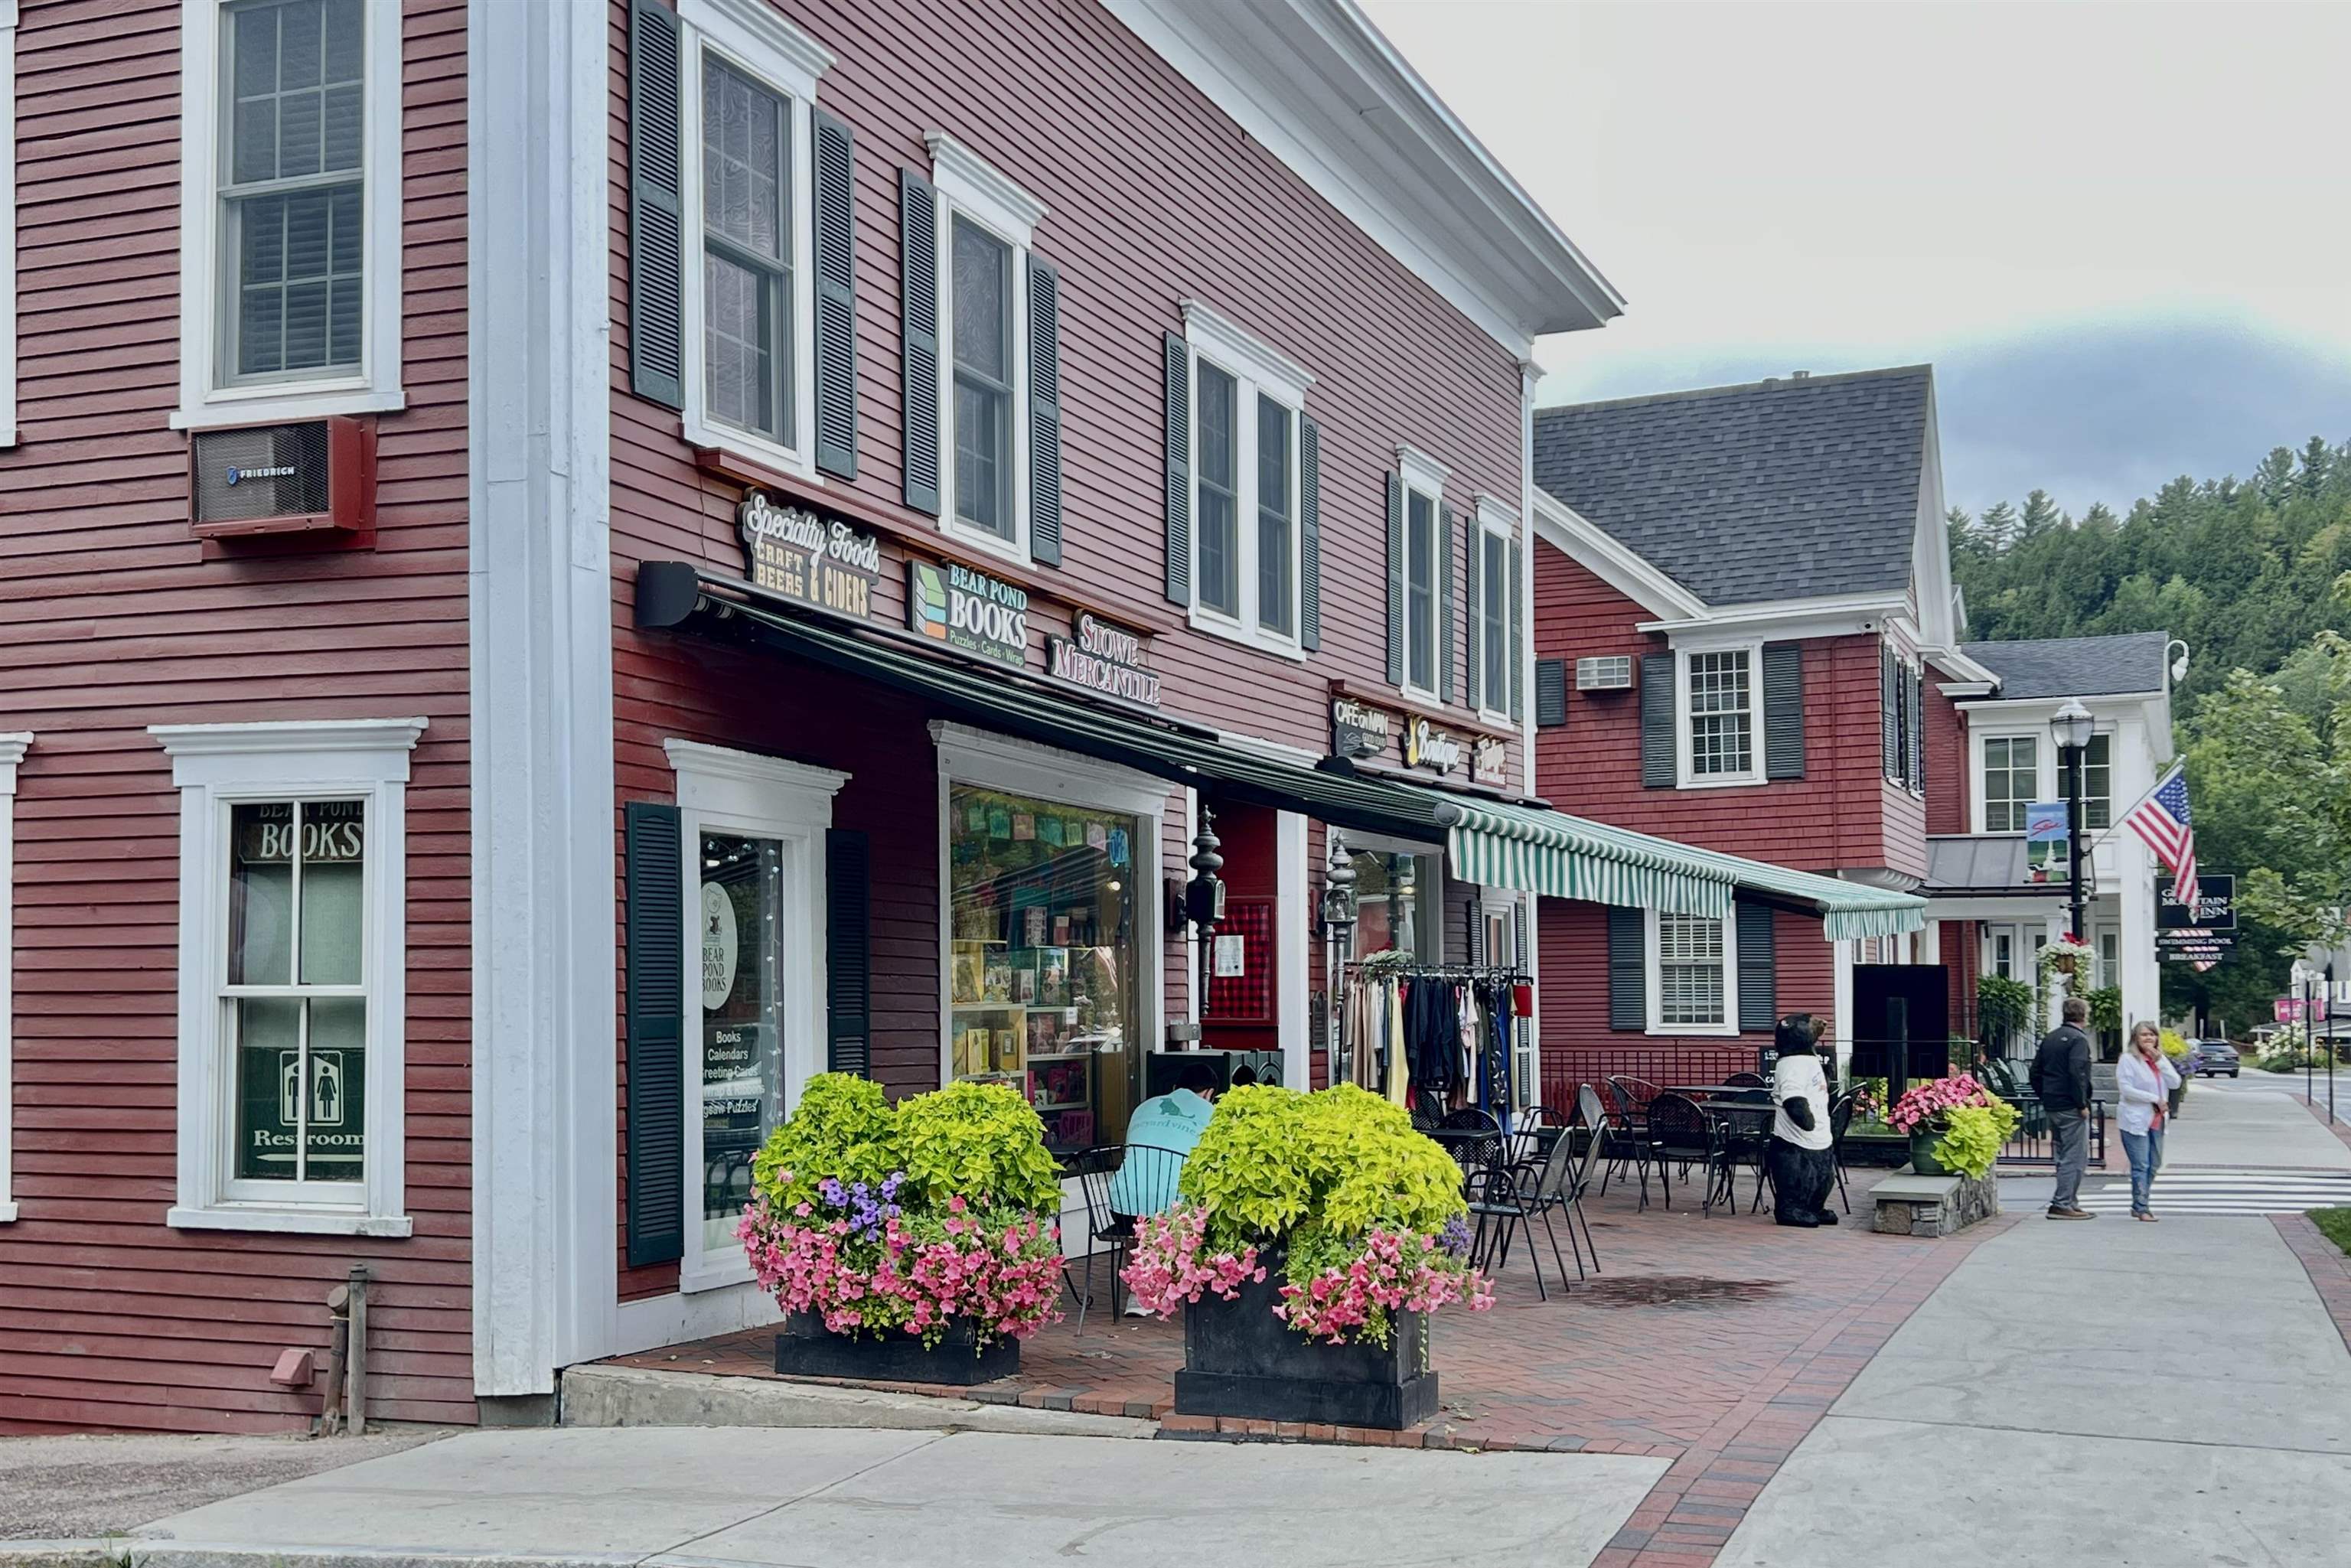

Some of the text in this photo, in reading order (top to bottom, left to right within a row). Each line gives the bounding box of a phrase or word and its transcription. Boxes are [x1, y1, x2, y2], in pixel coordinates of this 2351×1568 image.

[240, 466, 295, 479] FRIEDRICH
[746, 494, 880, 573] Specialty Foods
[755, 541, 804, 572] CRAFT
[756, 562, 867, 617] BEERS & CIDERS
[949, 563, 1027, 611] BEAR POND
[949, 588, 1027, 650] BOOKS
[950, 629, 1024, 667] Puzzles Cards Wrap
[1080, 614, 1138, 667] STOWE
[1052, 638, 1160, 707] MERCANTILE
[1335, 701, 1359, 727] CAFÉ
[260, 822, 364, 858] BOOKS
[2199, 907, 2228, 915] INN
[703, 947, 724, 962] BEAR
[703, 963, 724, 976] POND
[716, 1031, 741, 1044] Books
[708, 1048, 748, 1061] Calendars
[703, 1066, 733, 1081] reeting
[253, 1130, 364, 1146] Resroom
